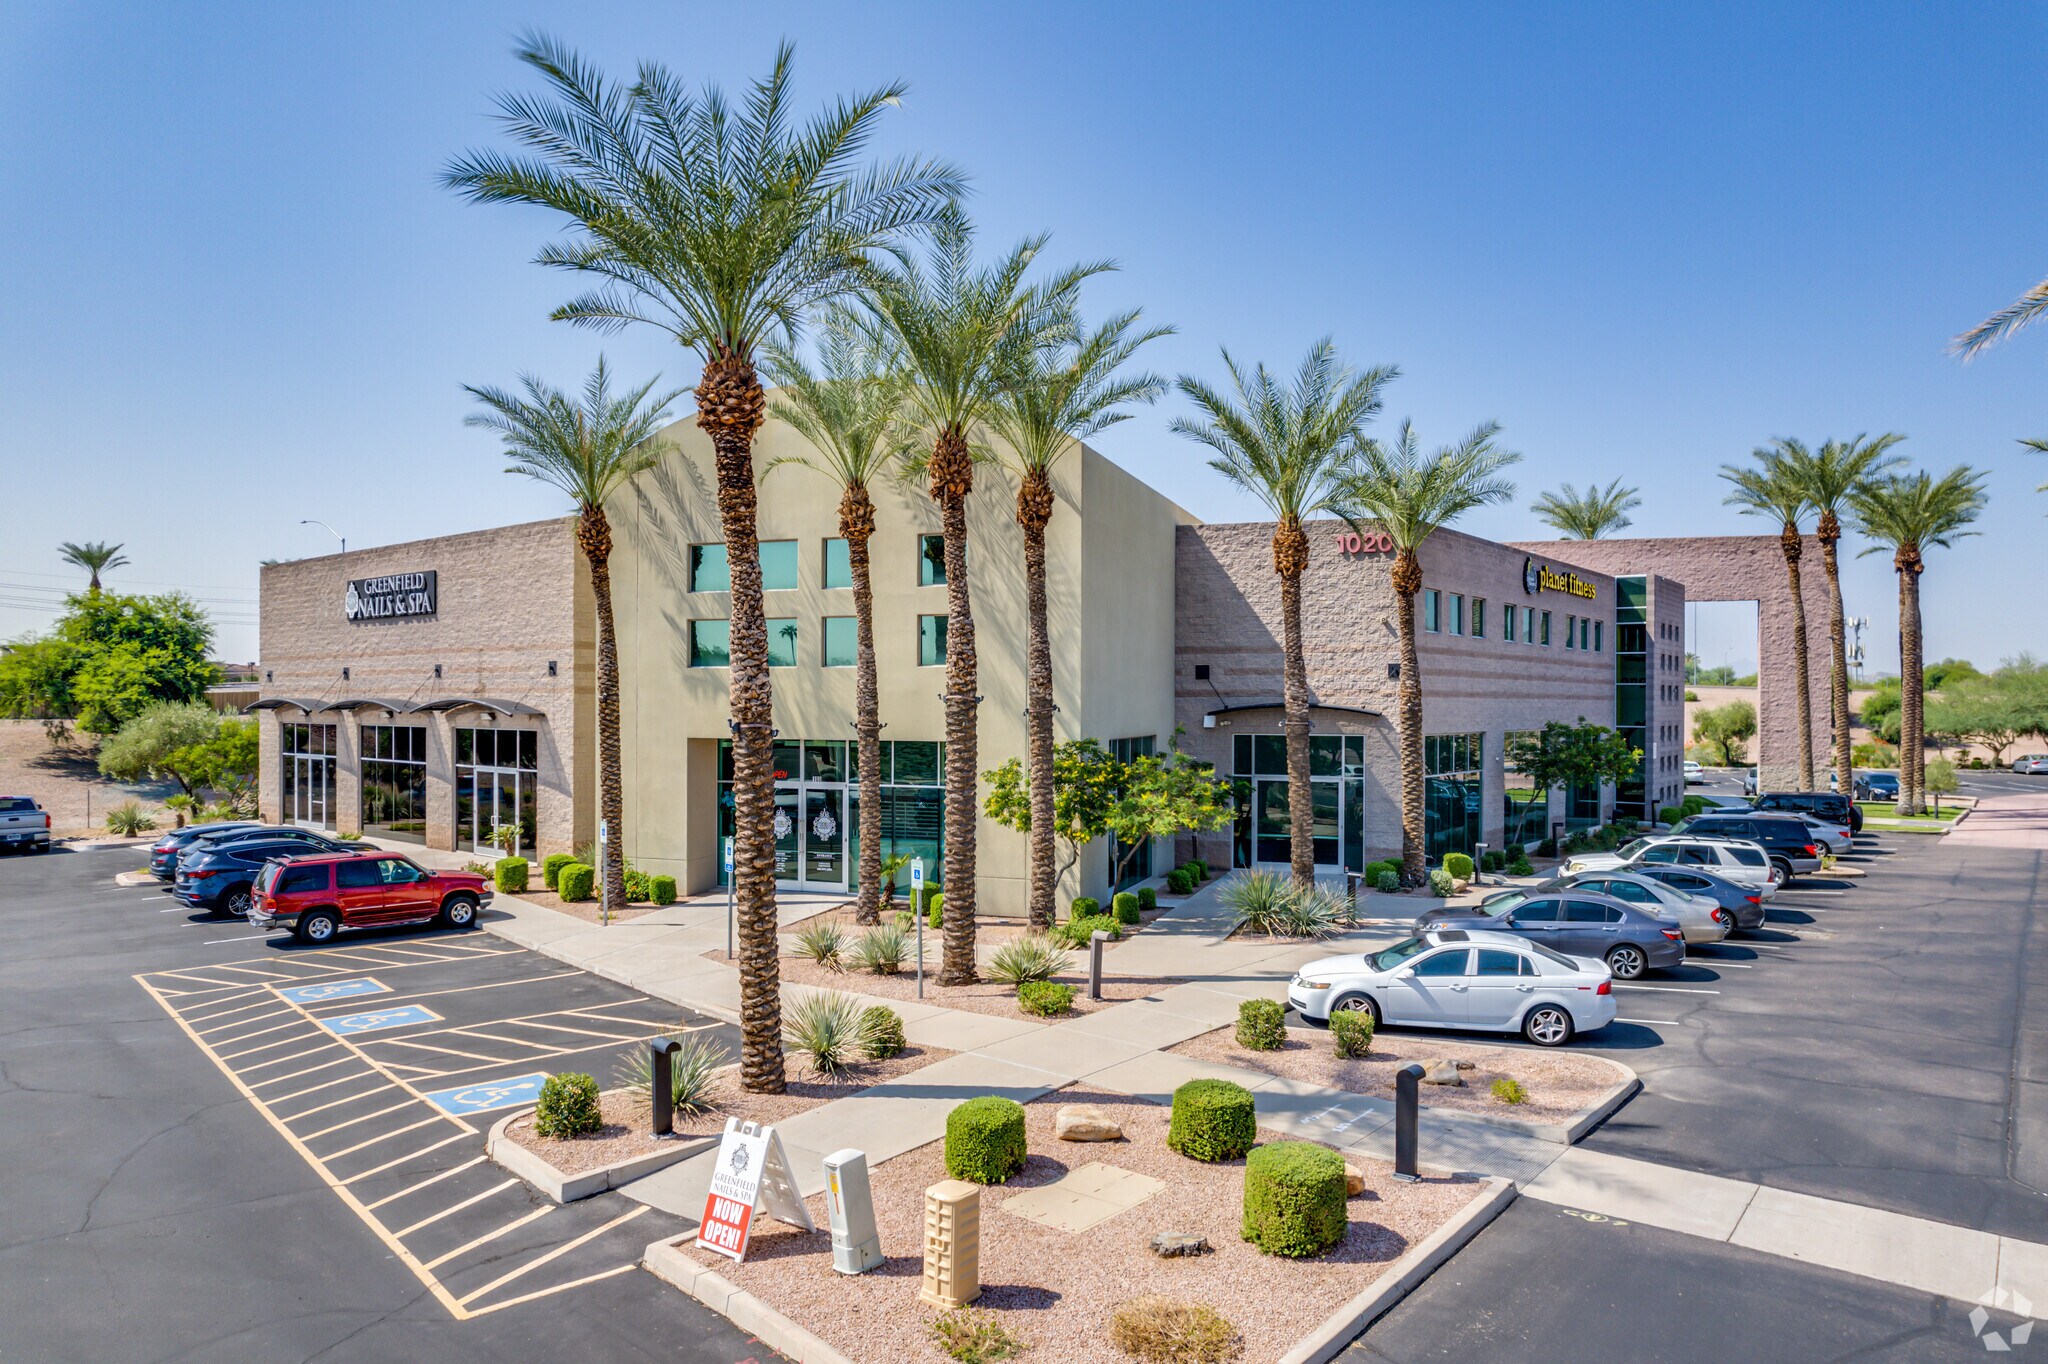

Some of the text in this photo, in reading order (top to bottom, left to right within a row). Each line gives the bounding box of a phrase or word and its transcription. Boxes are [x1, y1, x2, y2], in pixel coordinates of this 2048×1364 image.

[1336, 532, 1393, 553] 1020
[364, 573, 424, 594] GREENFIELD
[1540, 565, 1597, 599] planet fitness
[357, 591, 432, 618] NAILS & SPA
[773, 769, 788, 779] PEN
[714, 1172, 756, 1192] GREENFIELD
[714, 1183, 752, 1203] NAILS & SPA
[712, 1197, 745, 1226] NOW
[704, 1219, 742, 1251] OPEN!
